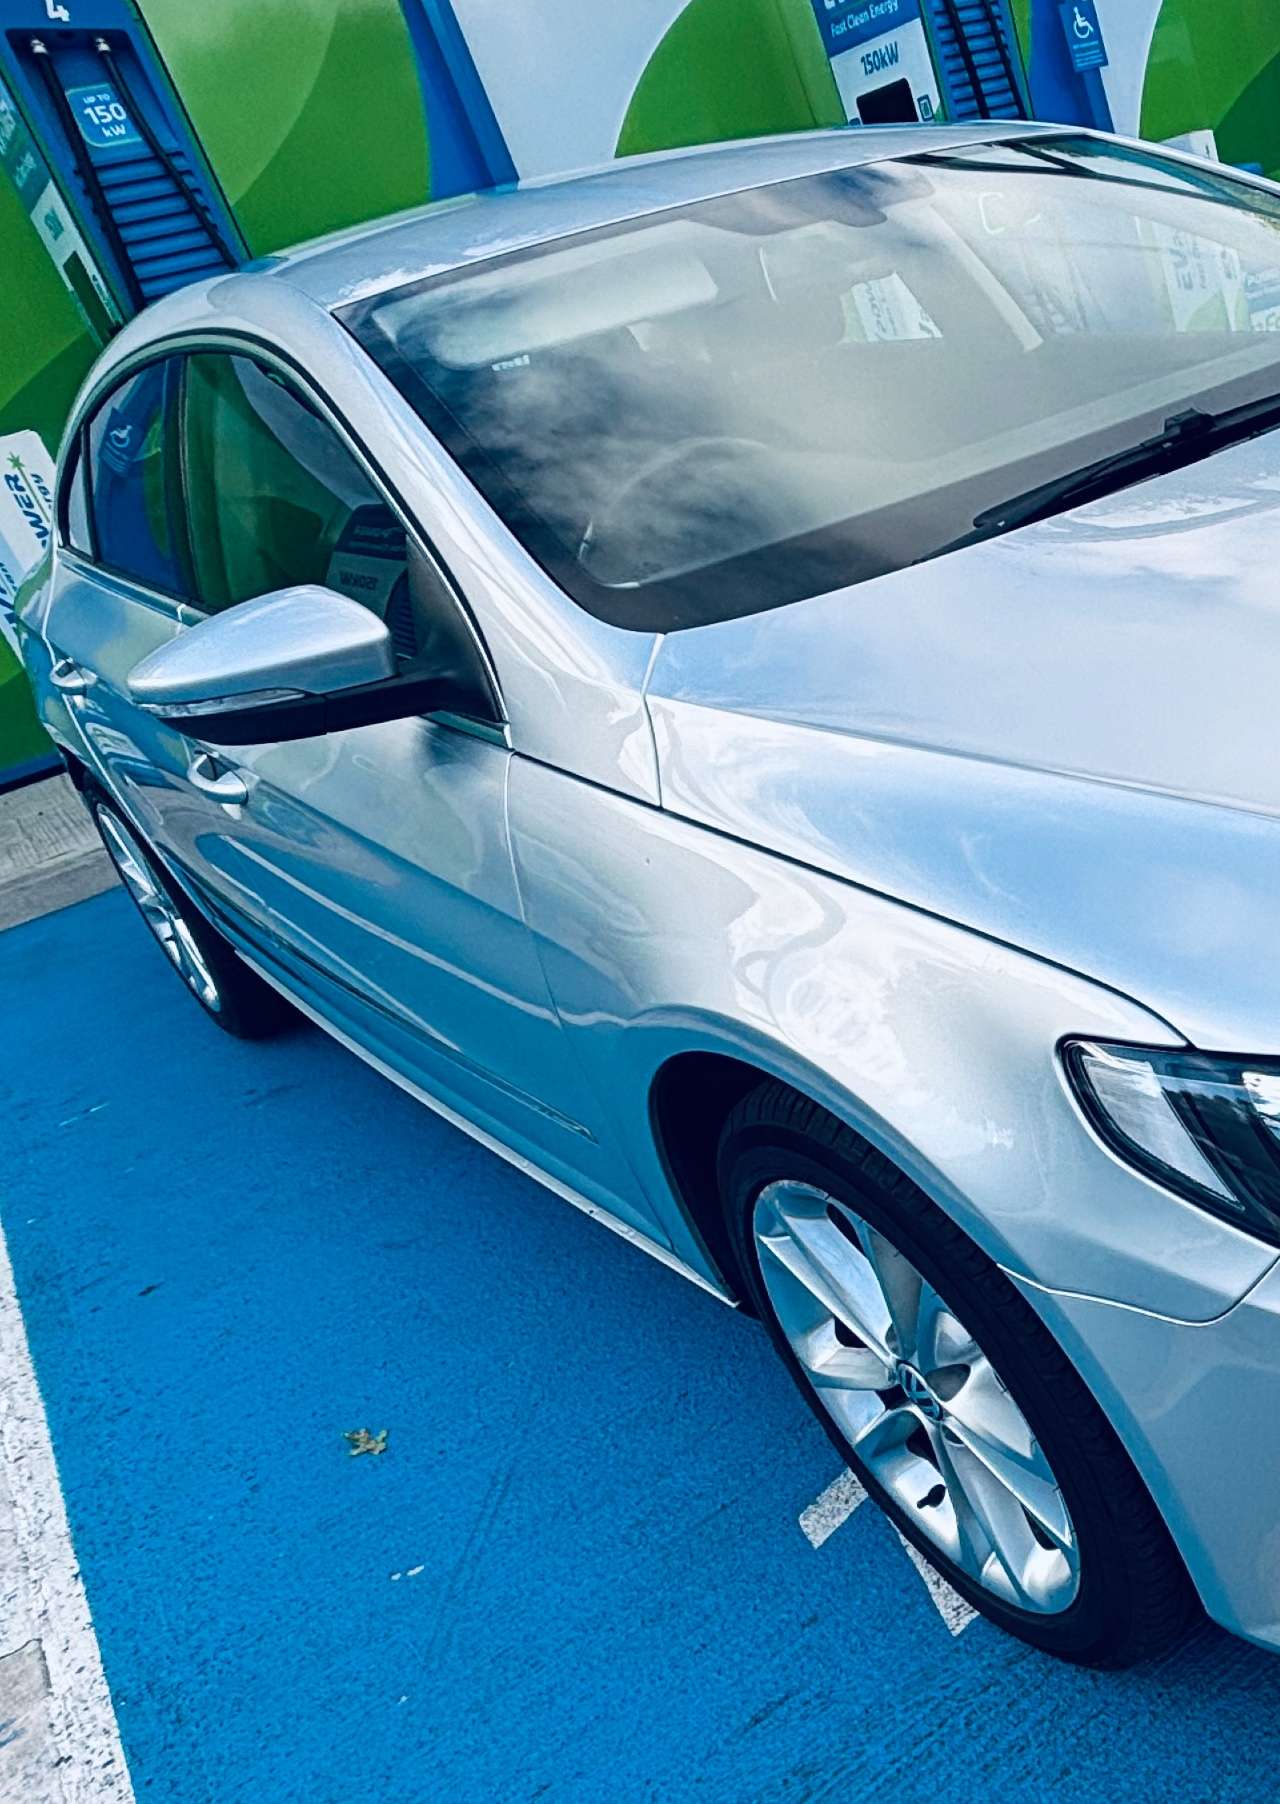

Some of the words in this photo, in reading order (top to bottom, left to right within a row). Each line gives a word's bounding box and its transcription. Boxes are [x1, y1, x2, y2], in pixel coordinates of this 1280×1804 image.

[831, 22, 848, 38] Fast
[847, 9, 870, 29] Clean
[869, 0, 899, 19] Energy
[860, 40, 899, 76] 150kW
[83, 95, 96, 104] UP
[83, 102, 127, 125] 150
[101, 124, 127, 138] kW
[4, 473, 50, 549] WER
